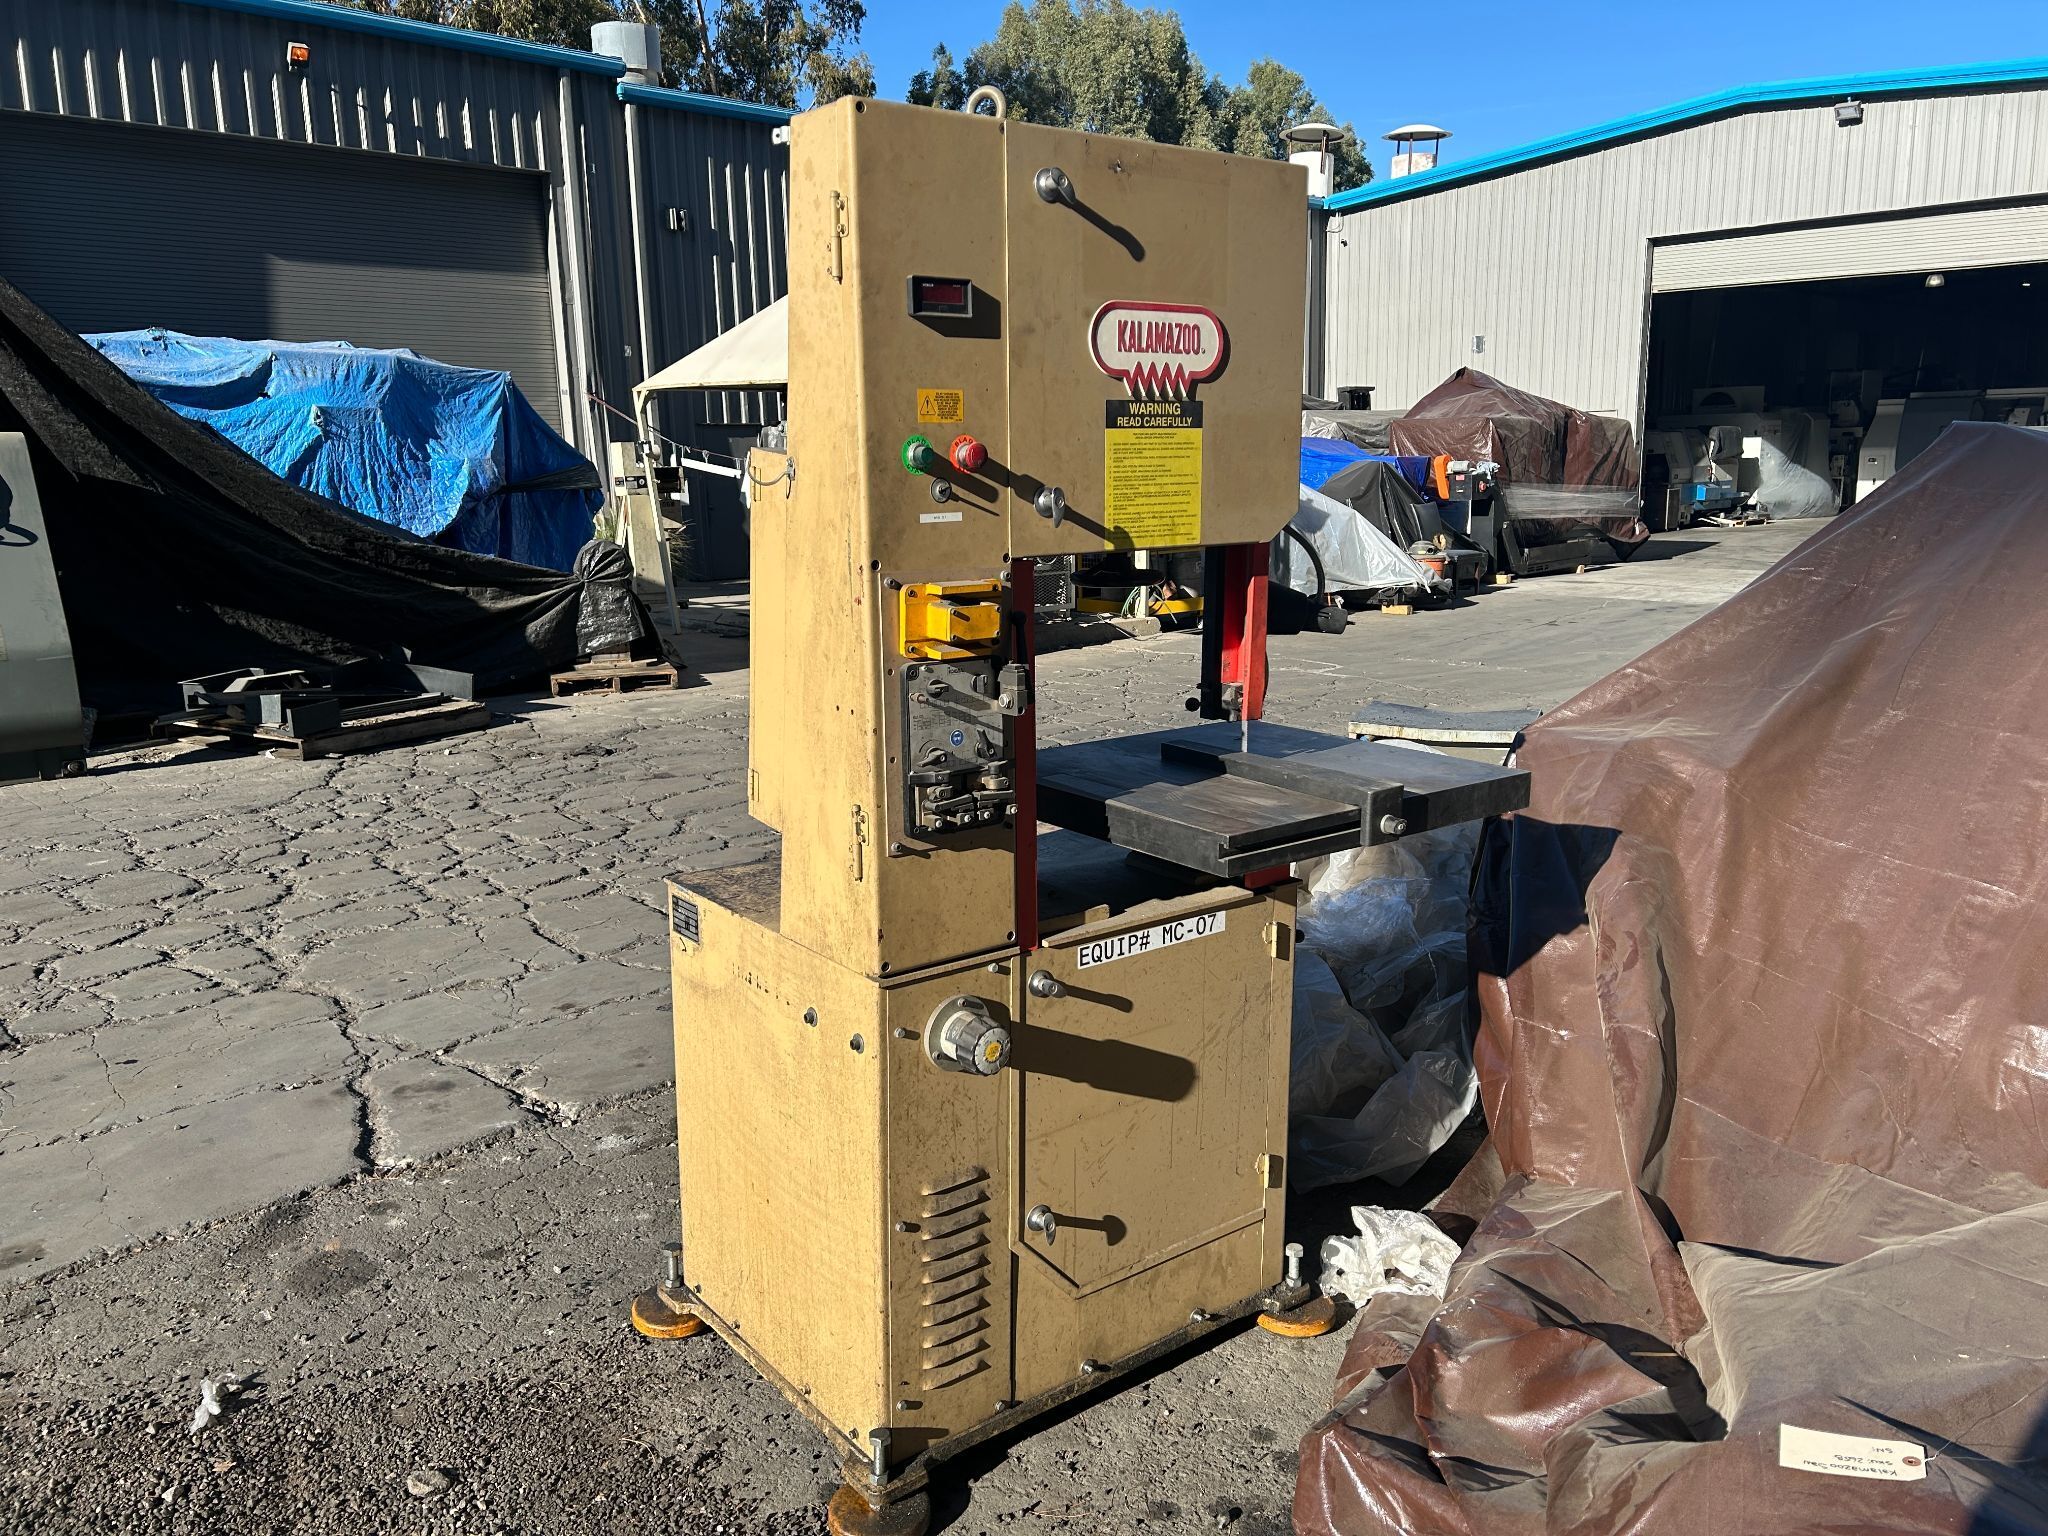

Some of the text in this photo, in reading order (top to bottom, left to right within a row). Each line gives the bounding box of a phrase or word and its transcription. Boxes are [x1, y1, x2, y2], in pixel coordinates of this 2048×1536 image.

[1117, 320, 1201, 355] KALAMAZOO
[1129, 402, 1181, 415] WARNING
[1117, 418, 1193, 427] READ CAREFULLY
[954, 437, 974, 447] BLAD
[1079, 913, 1217, 967] EQUIP# MC-07
